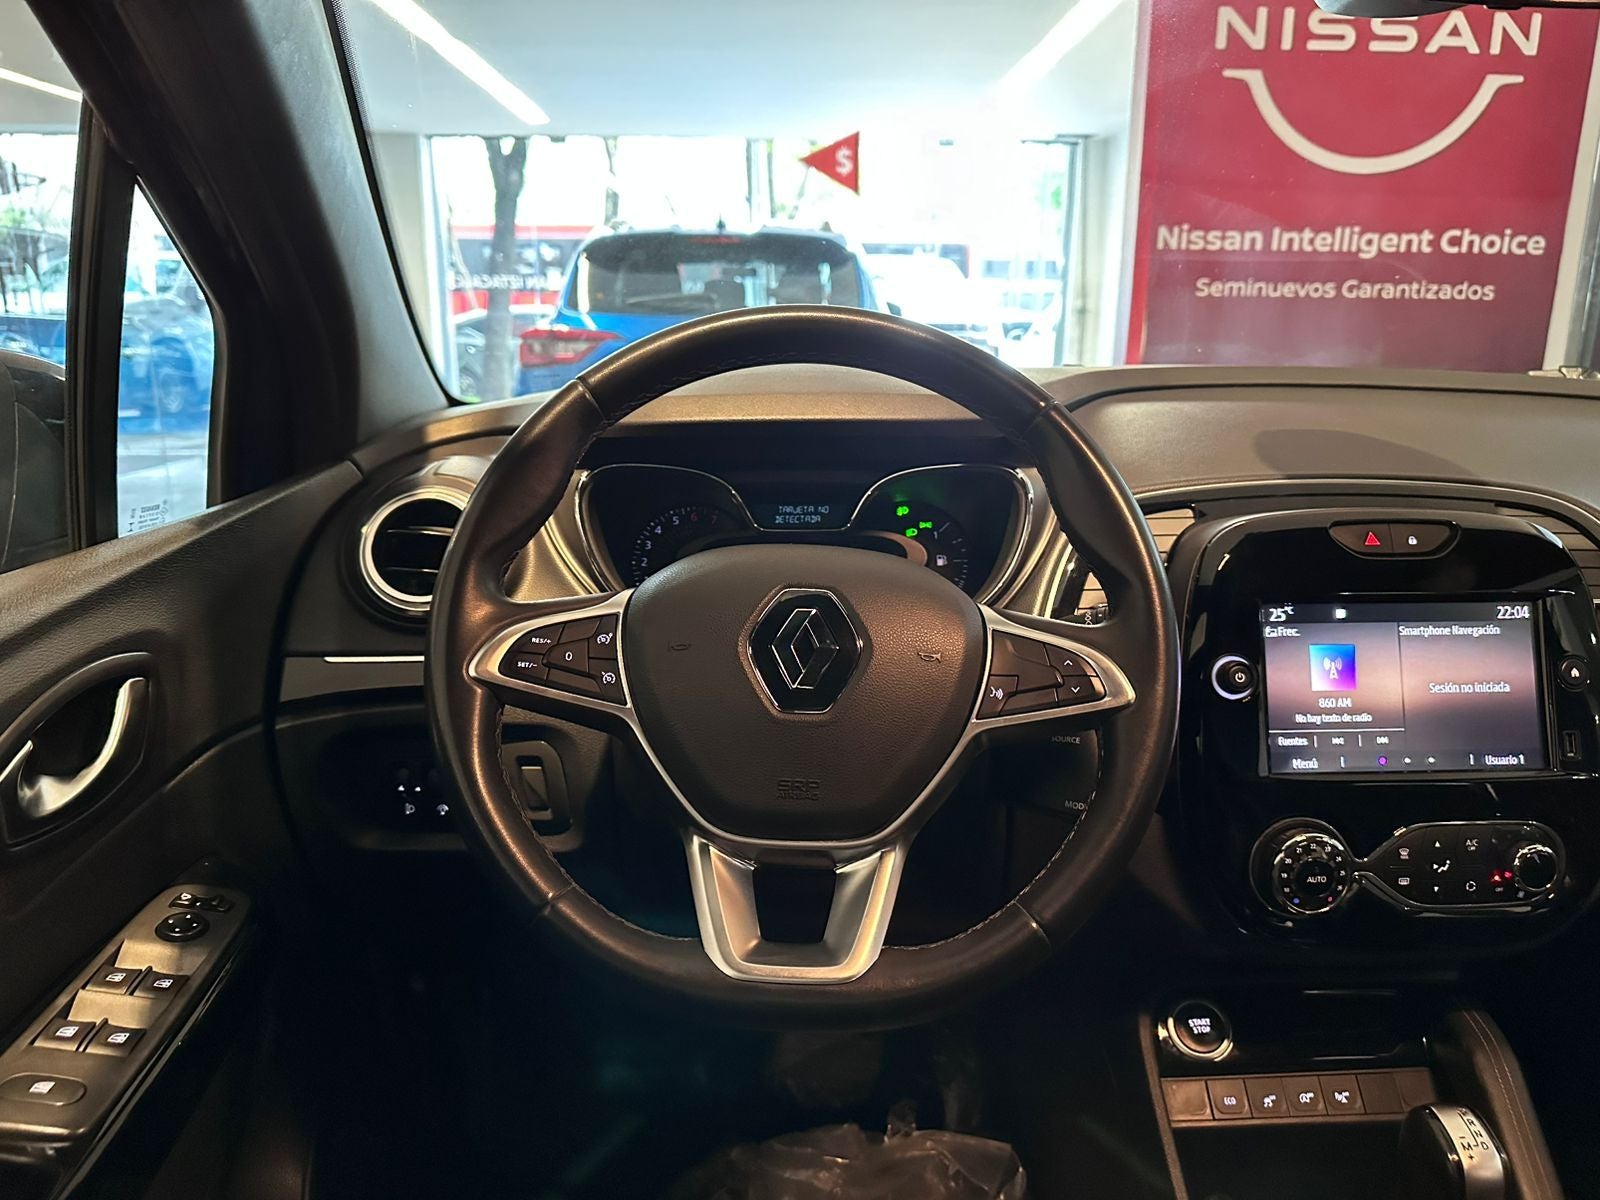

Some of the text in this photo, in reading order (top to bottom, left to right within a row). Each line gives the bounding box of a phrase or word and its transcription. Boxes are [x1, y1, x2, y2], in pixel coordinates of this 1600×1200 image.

[1214, 6, 1542, 56] NISSAN
[834, 146, 854, 177] $
[1156, 224, 1546, 260] Nissan Intelligent Choice
[1195, 276, 1495, 302] Seminuevos Garantizados
[672, 516, 680, 525] 5
[653, 525, 662, 534] 4
[644, 540, 652, 550] 3
[640, 557, 648, 567] 2
[1496, 606, 1530, 619] 22:04
[1399, 624, 1501, 638] Smartphone Navegación
[1429, 681, 1511, 694] Sesión no iniciada
[1318, 697, 1352, 708] 860 AM
[1342, 713, 1352, 722] de
[1352, 712, 1373, 722] radio
[1277, 736, 1308, 746] Fuentes
[1485, 753, 1525, 767] Usuario 1
[1188, 1017, 1211, 1027] START
[1192, 1025, 1211, 1035] STOP
[1223, 1096, 1237, 1105] ECO
[1466, 1118, 1477, 1127] R
[1460, 1142, 1473, 1151] M
